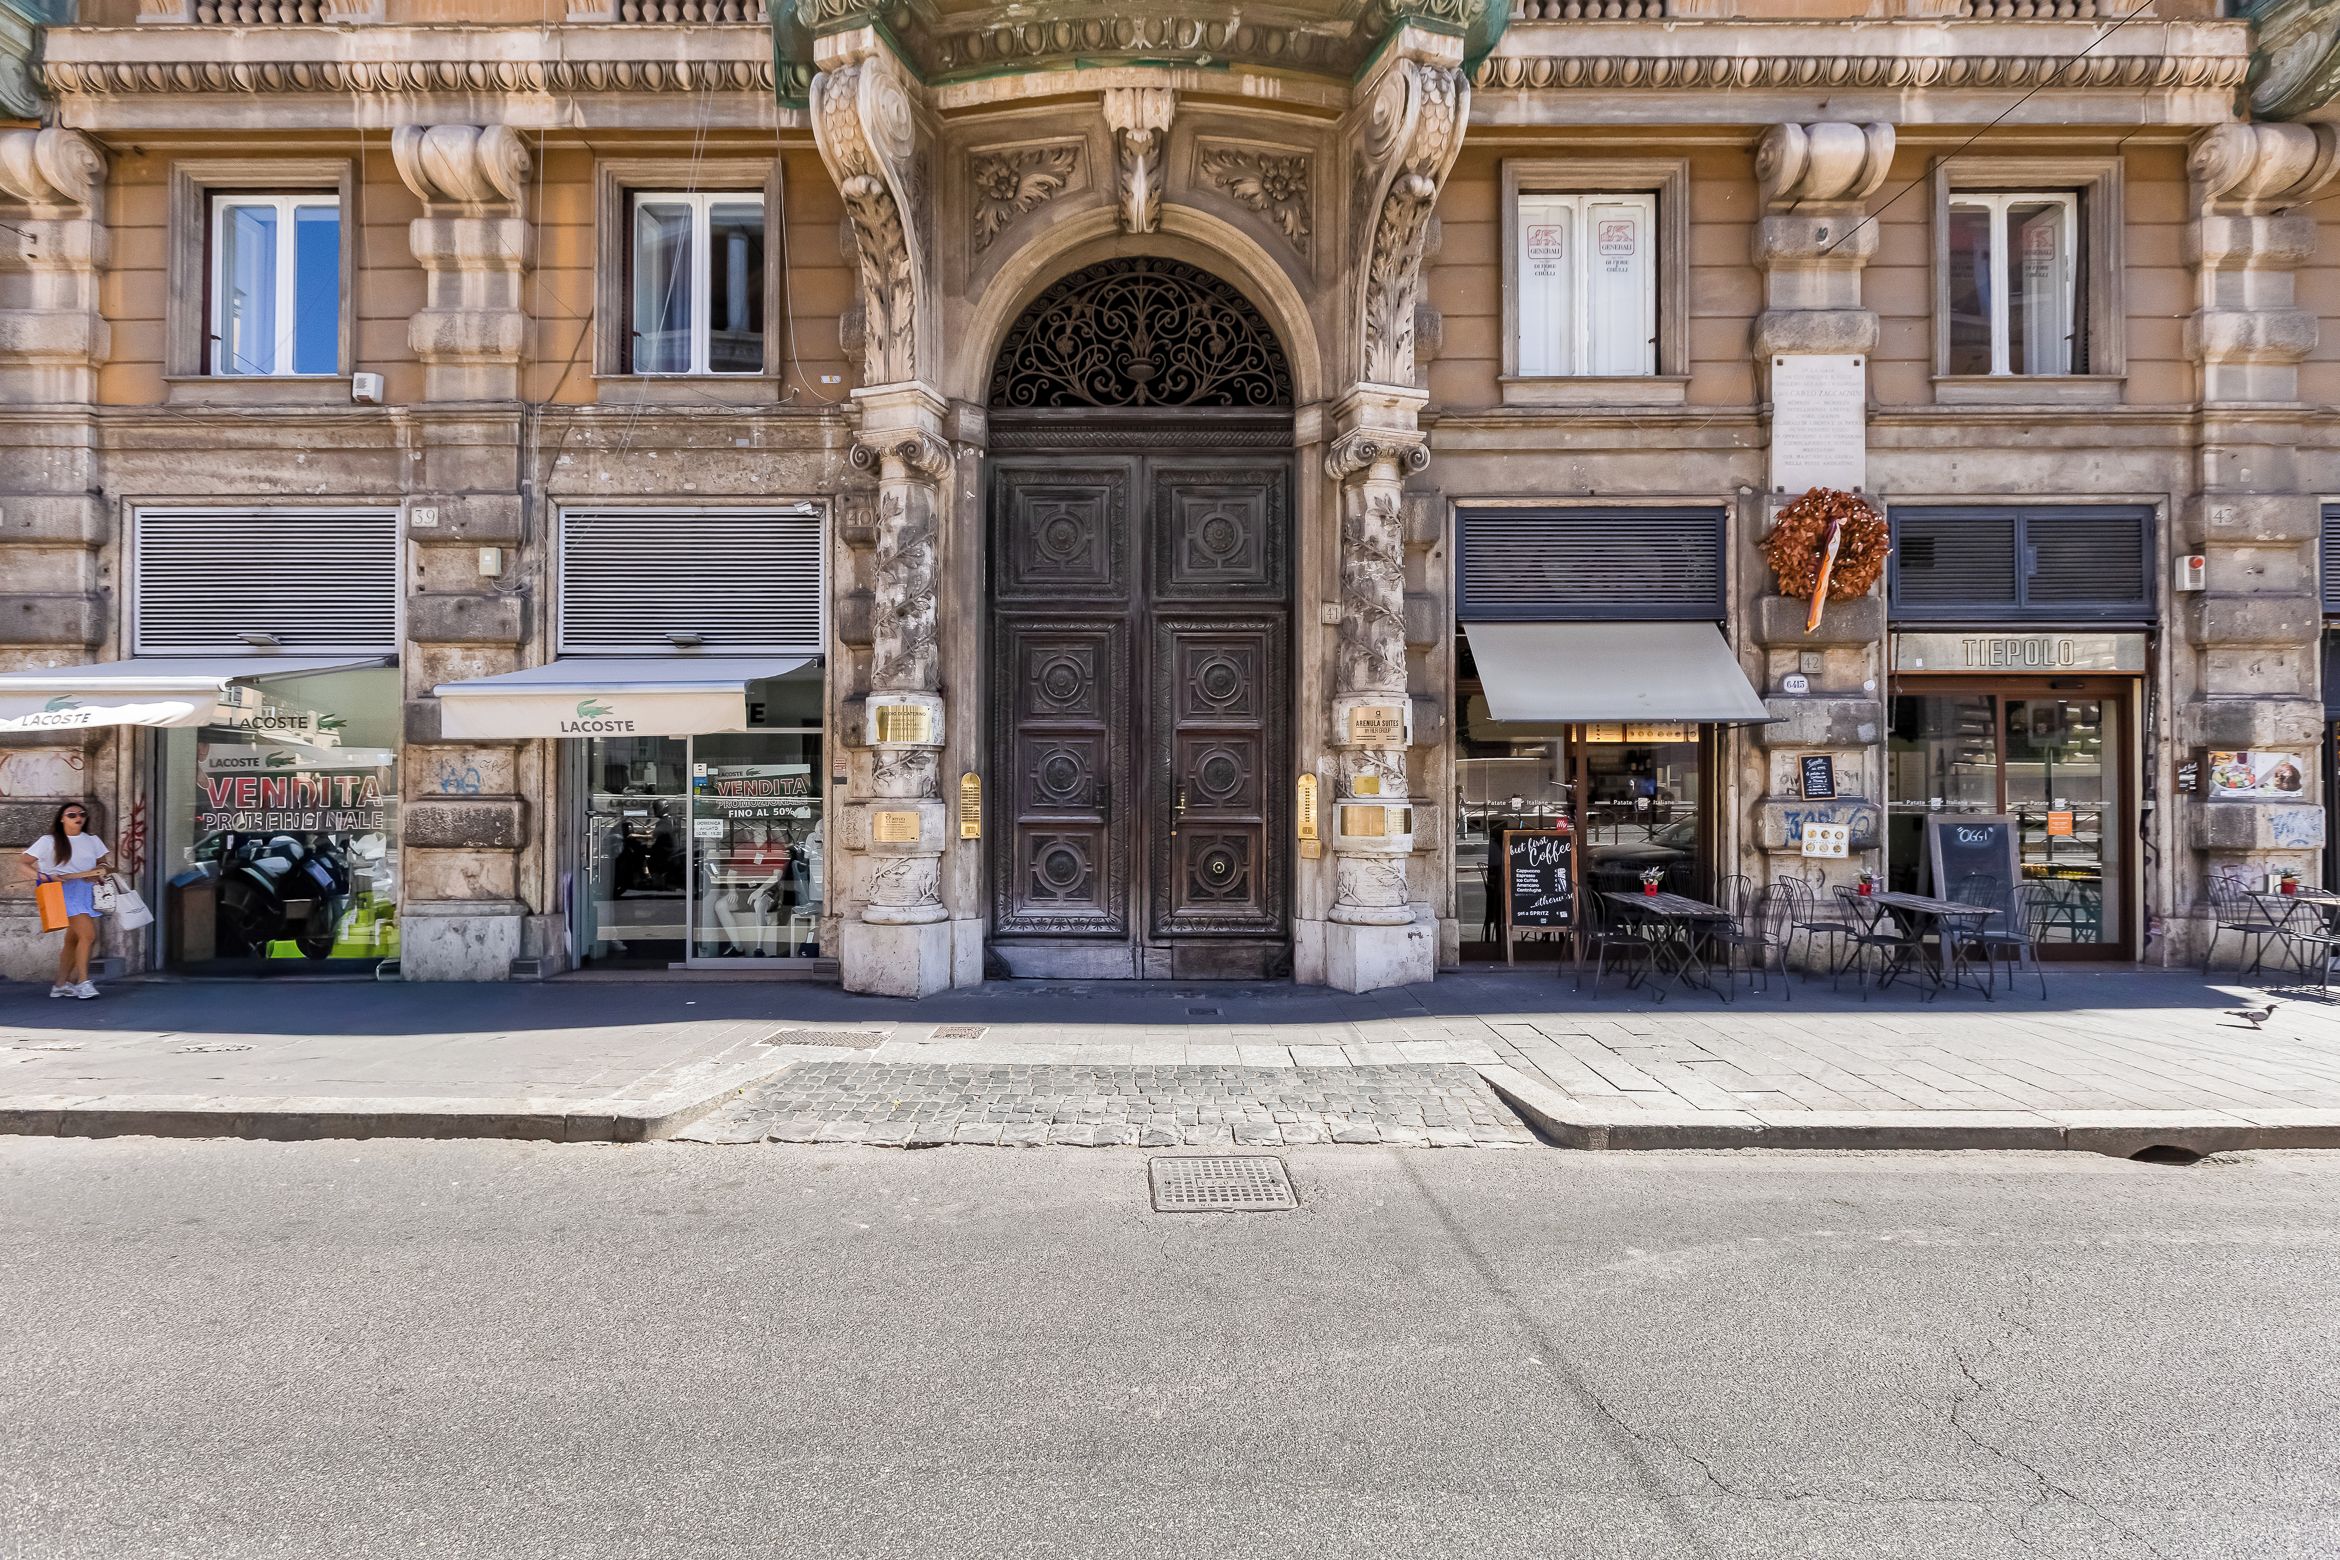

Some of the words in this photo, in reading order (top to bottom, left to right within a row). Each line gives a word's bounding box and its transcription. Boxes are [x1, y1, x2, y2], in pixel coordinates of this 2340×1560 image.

[415, 509, 436, 524] 39
[1326, 607, 1338, 620] 41
[1962, 639, 2075, 667] TIEPOLO
[1804, 656, 1819, 669] 42
[21, 712, 92, 727] LACOSTE
[229, 716, 309, 730] LACOSTE
[560, 720, 635, 733] LACOSTE
[1355, 719, 1381, 727] ARENULA
[1381, 719, 1399, 727] SUITES
[209, 757, 260, 768] LACOSTE
[207, 776, 384, 810] VENDITA
[716, 778, 808, 798] VENDITA
[728, 809, 753, 818] FINO
[756, 809, 770, 817] AL
[773, 807, 796, 817] 50%
[1509, 842, 1527, 856] but
[1527, 836, 1549, 853] first
[1529, 840, 1572, 867] Coffee
